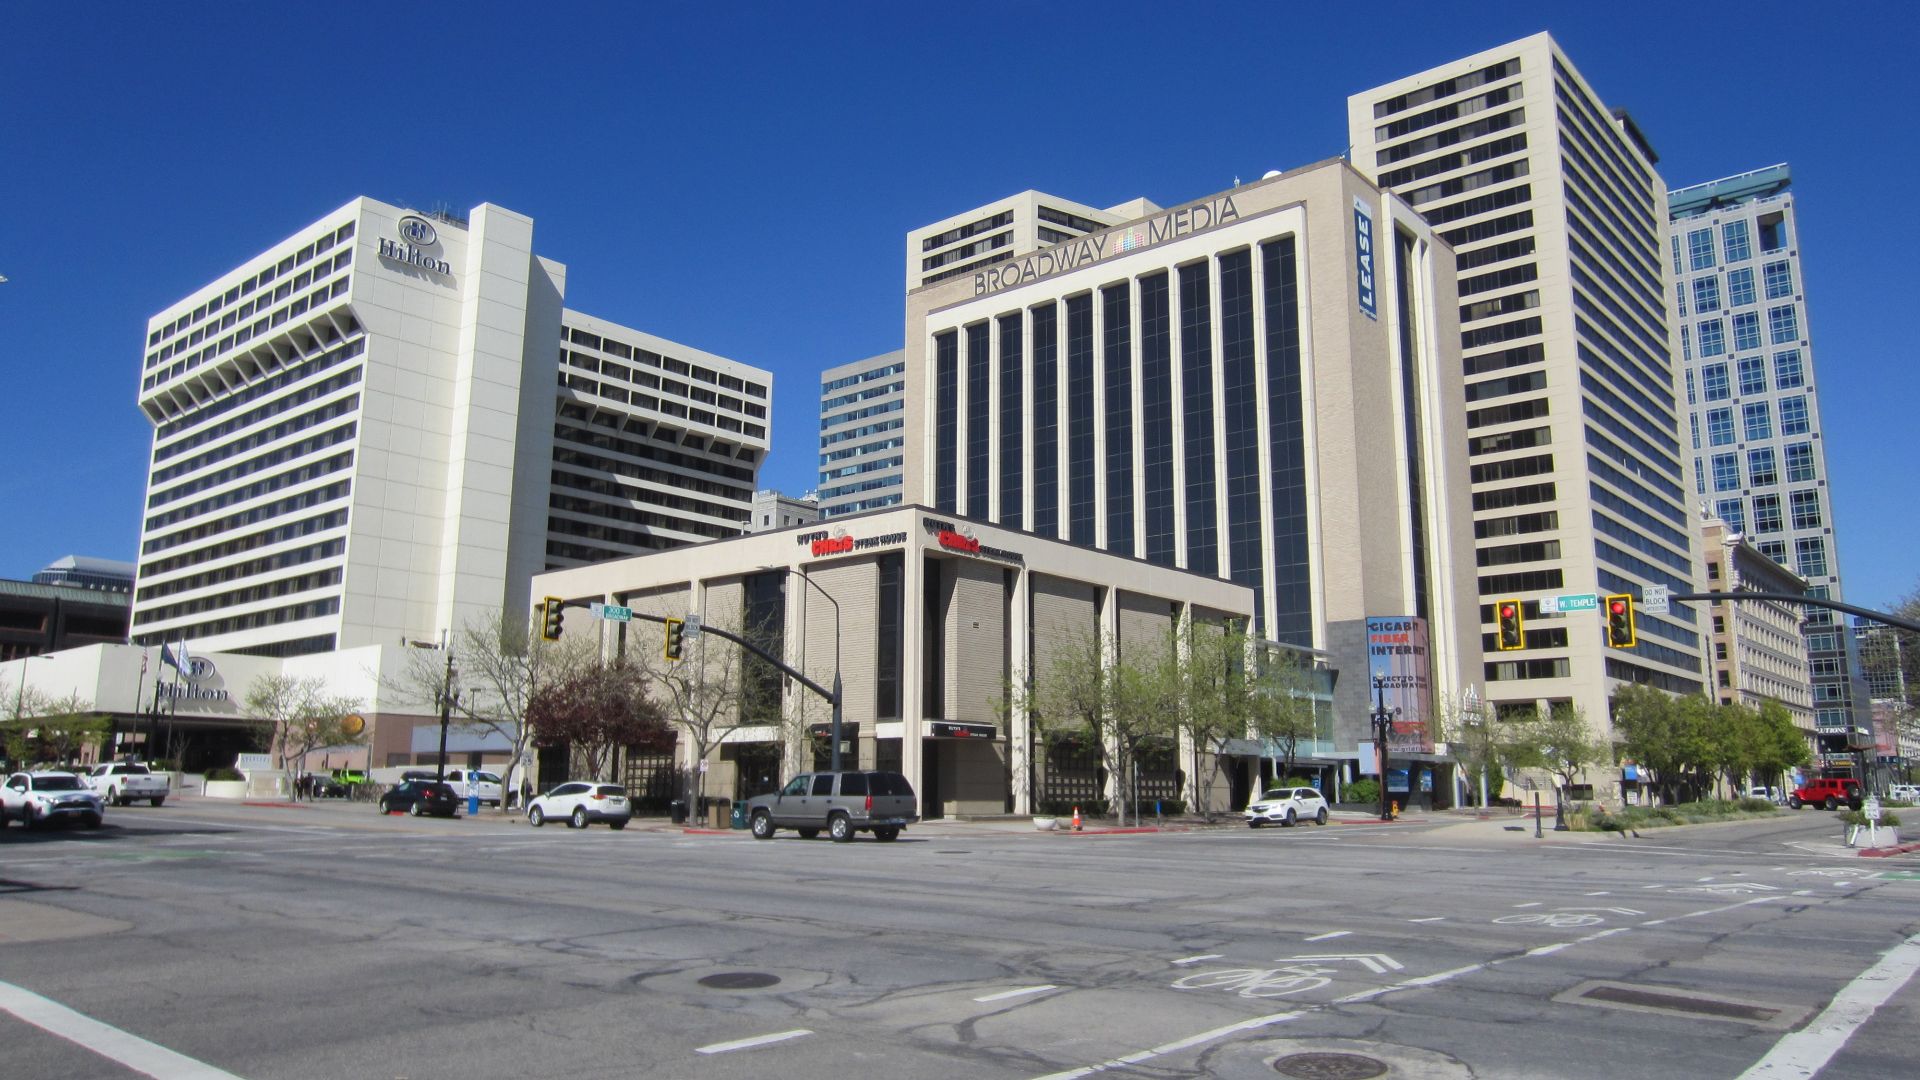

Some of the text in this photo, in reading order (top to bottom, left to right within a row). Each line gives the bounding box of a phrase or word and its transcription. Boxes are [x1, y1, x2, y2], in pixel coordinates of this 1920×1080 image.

[974, 195, 1241, 296] BROADWAY MEDIA
[377, 237, 451, 275] Hilton
[1358, 215, 1373, 307] LEASE
[812, 536, 853, 556] CHRIS
[1655, 587, 1665, 595] NOT
[1559, 598, 1595, 608] W. TEMPLE
[1371, 634, 1409, 643] FIBER
